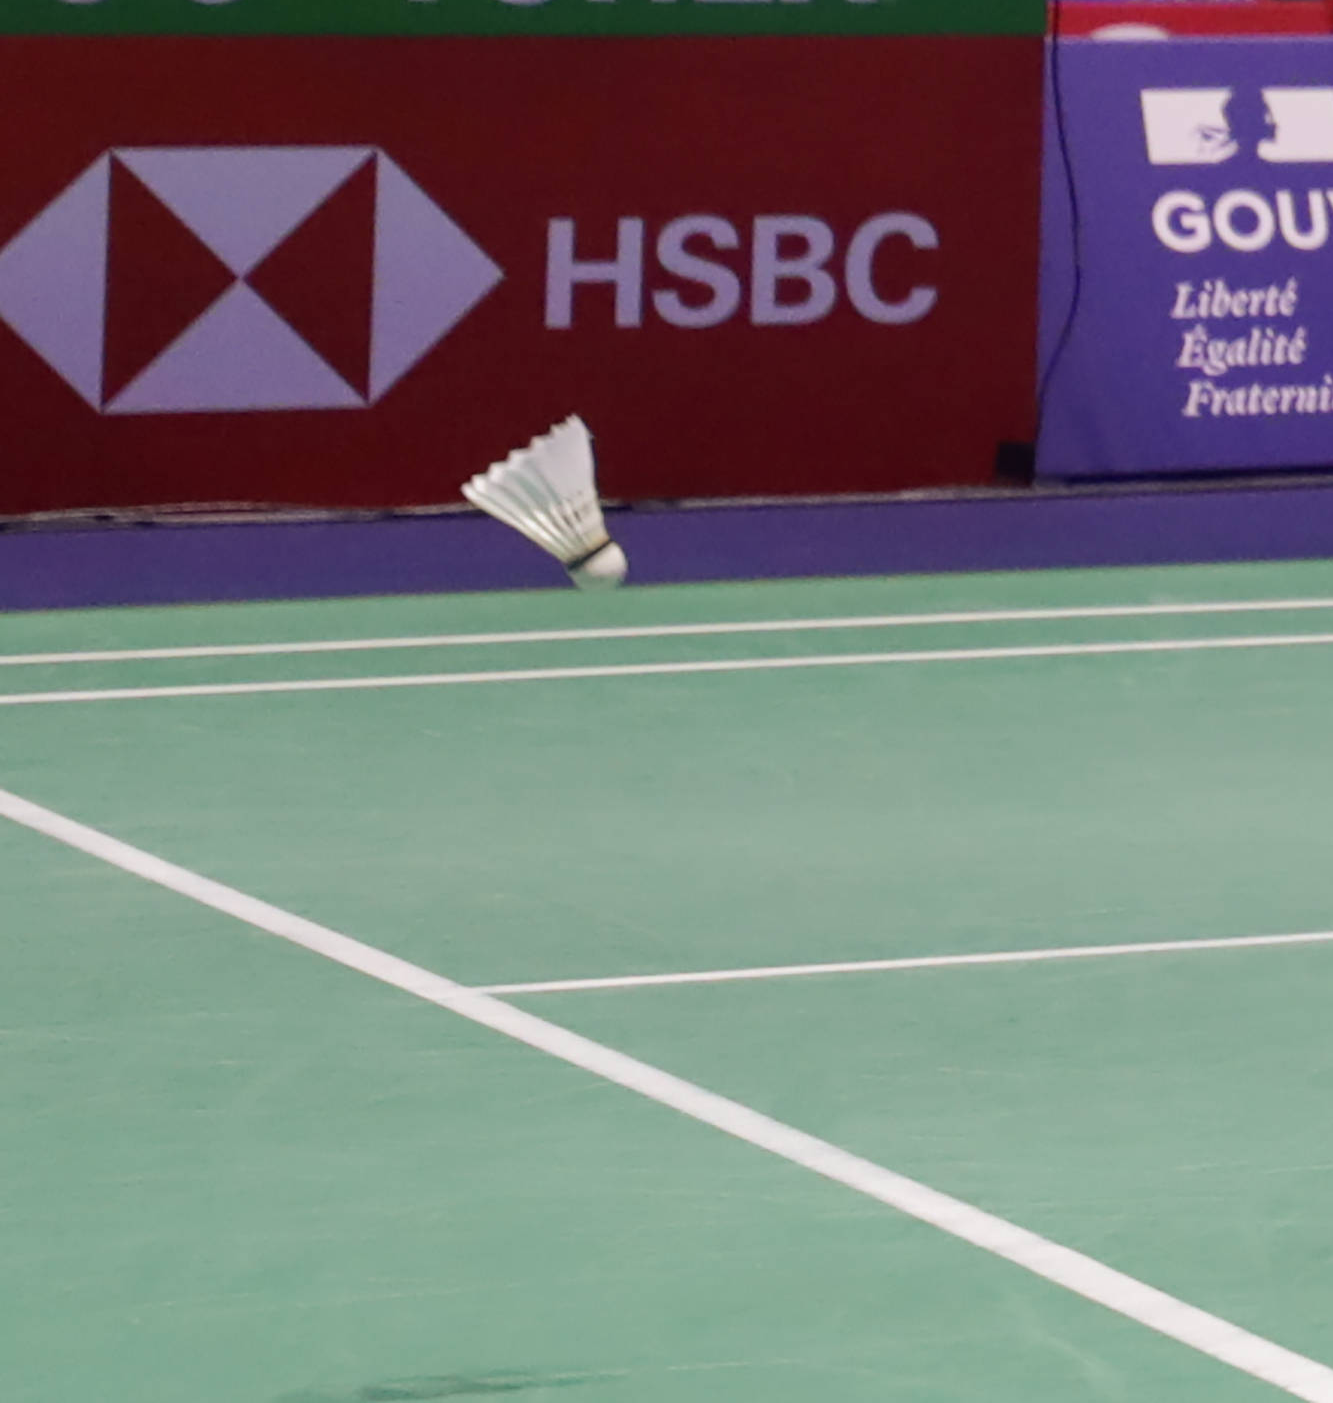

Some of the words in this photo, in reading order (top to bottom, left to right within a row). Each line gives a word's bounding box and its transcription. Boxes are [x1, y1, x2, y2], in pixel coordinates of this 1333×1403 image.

[544, 211, 939, 330] HSBC
[1170, 276, 1298, 319] Liberté
[1176, 323, 1307, 376] Égalité
